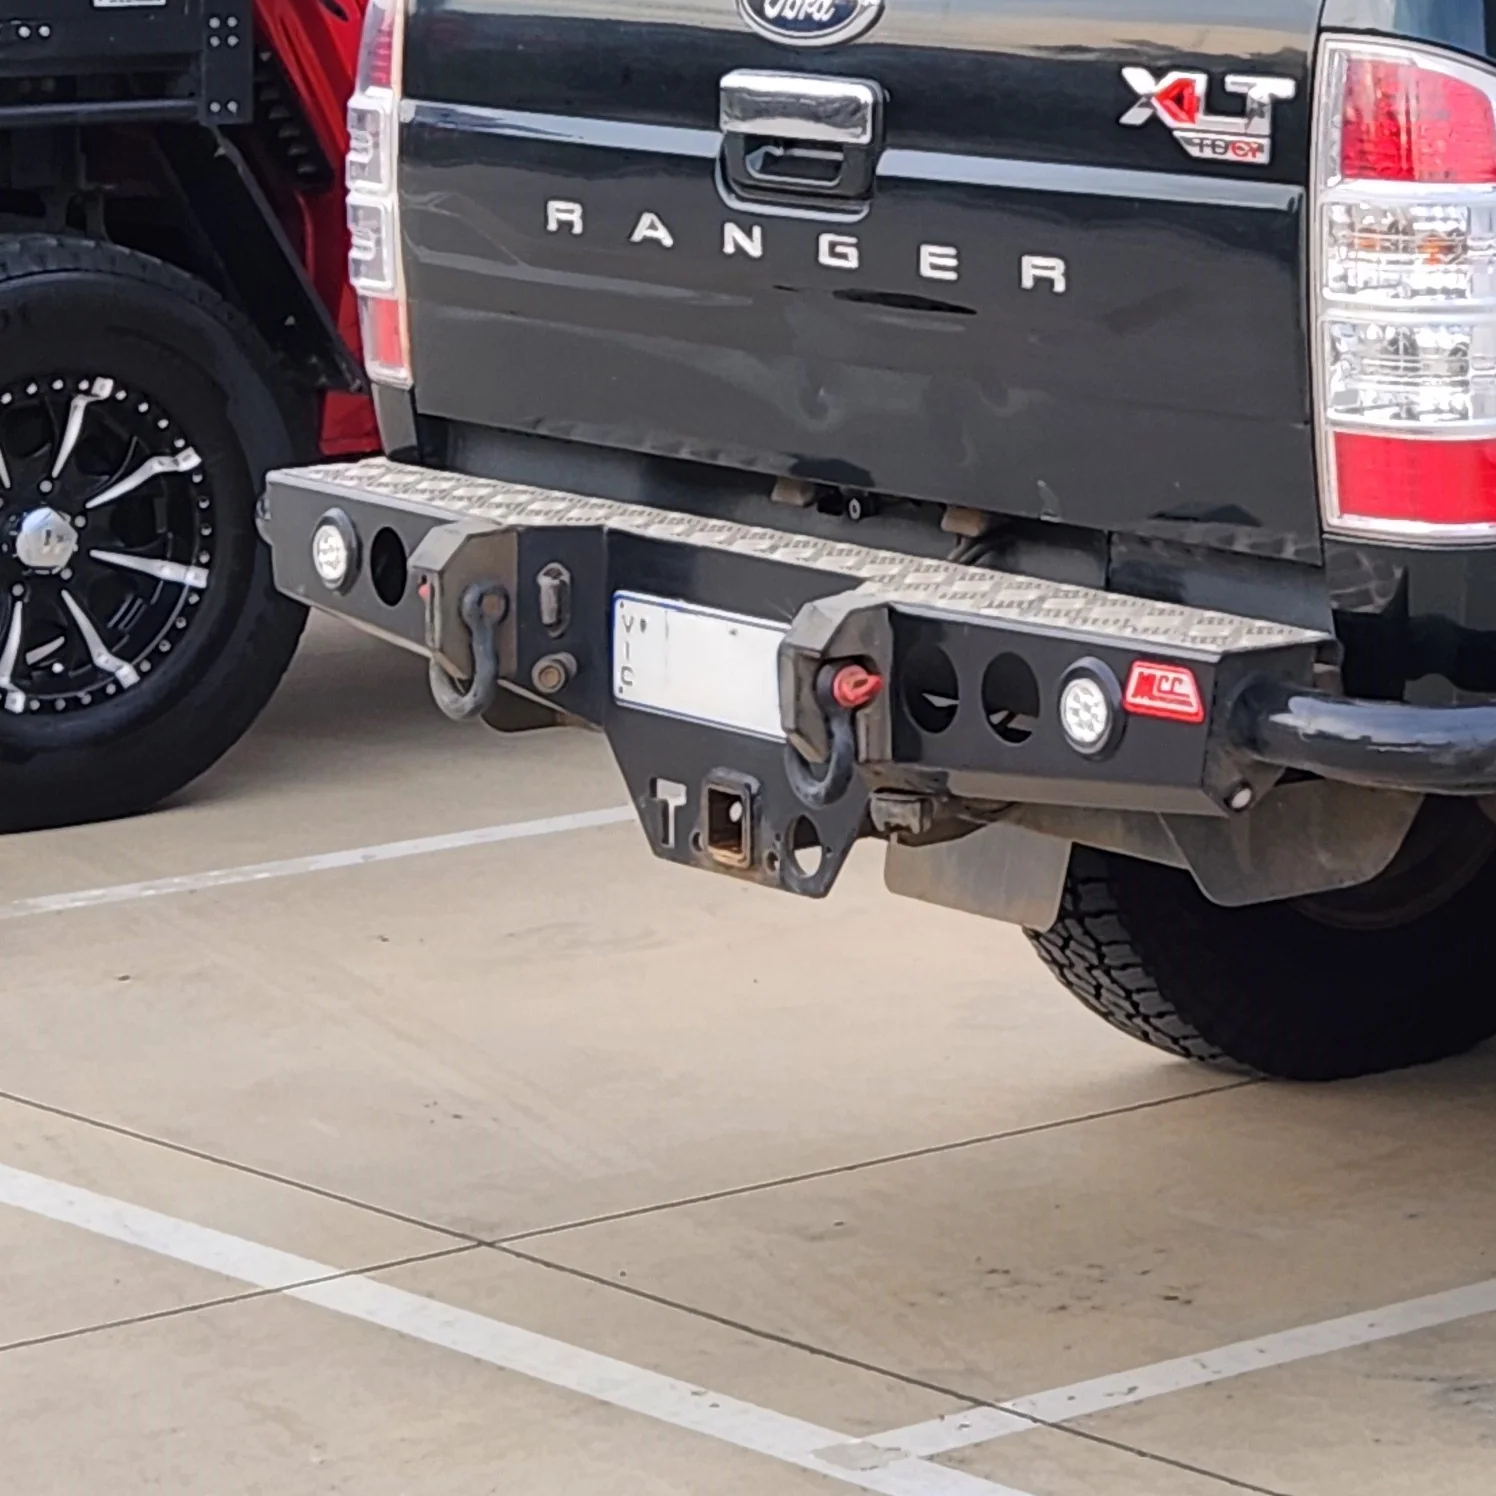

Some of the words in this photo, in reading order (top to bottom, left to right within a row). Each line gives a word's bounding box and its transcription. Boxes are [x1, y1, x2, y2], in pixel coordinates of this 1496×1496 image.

[1119, 66, 1296, 135] XLT
[545, 199, 1067, 292] RANGER
[620, 614, 634, 686] VIC
